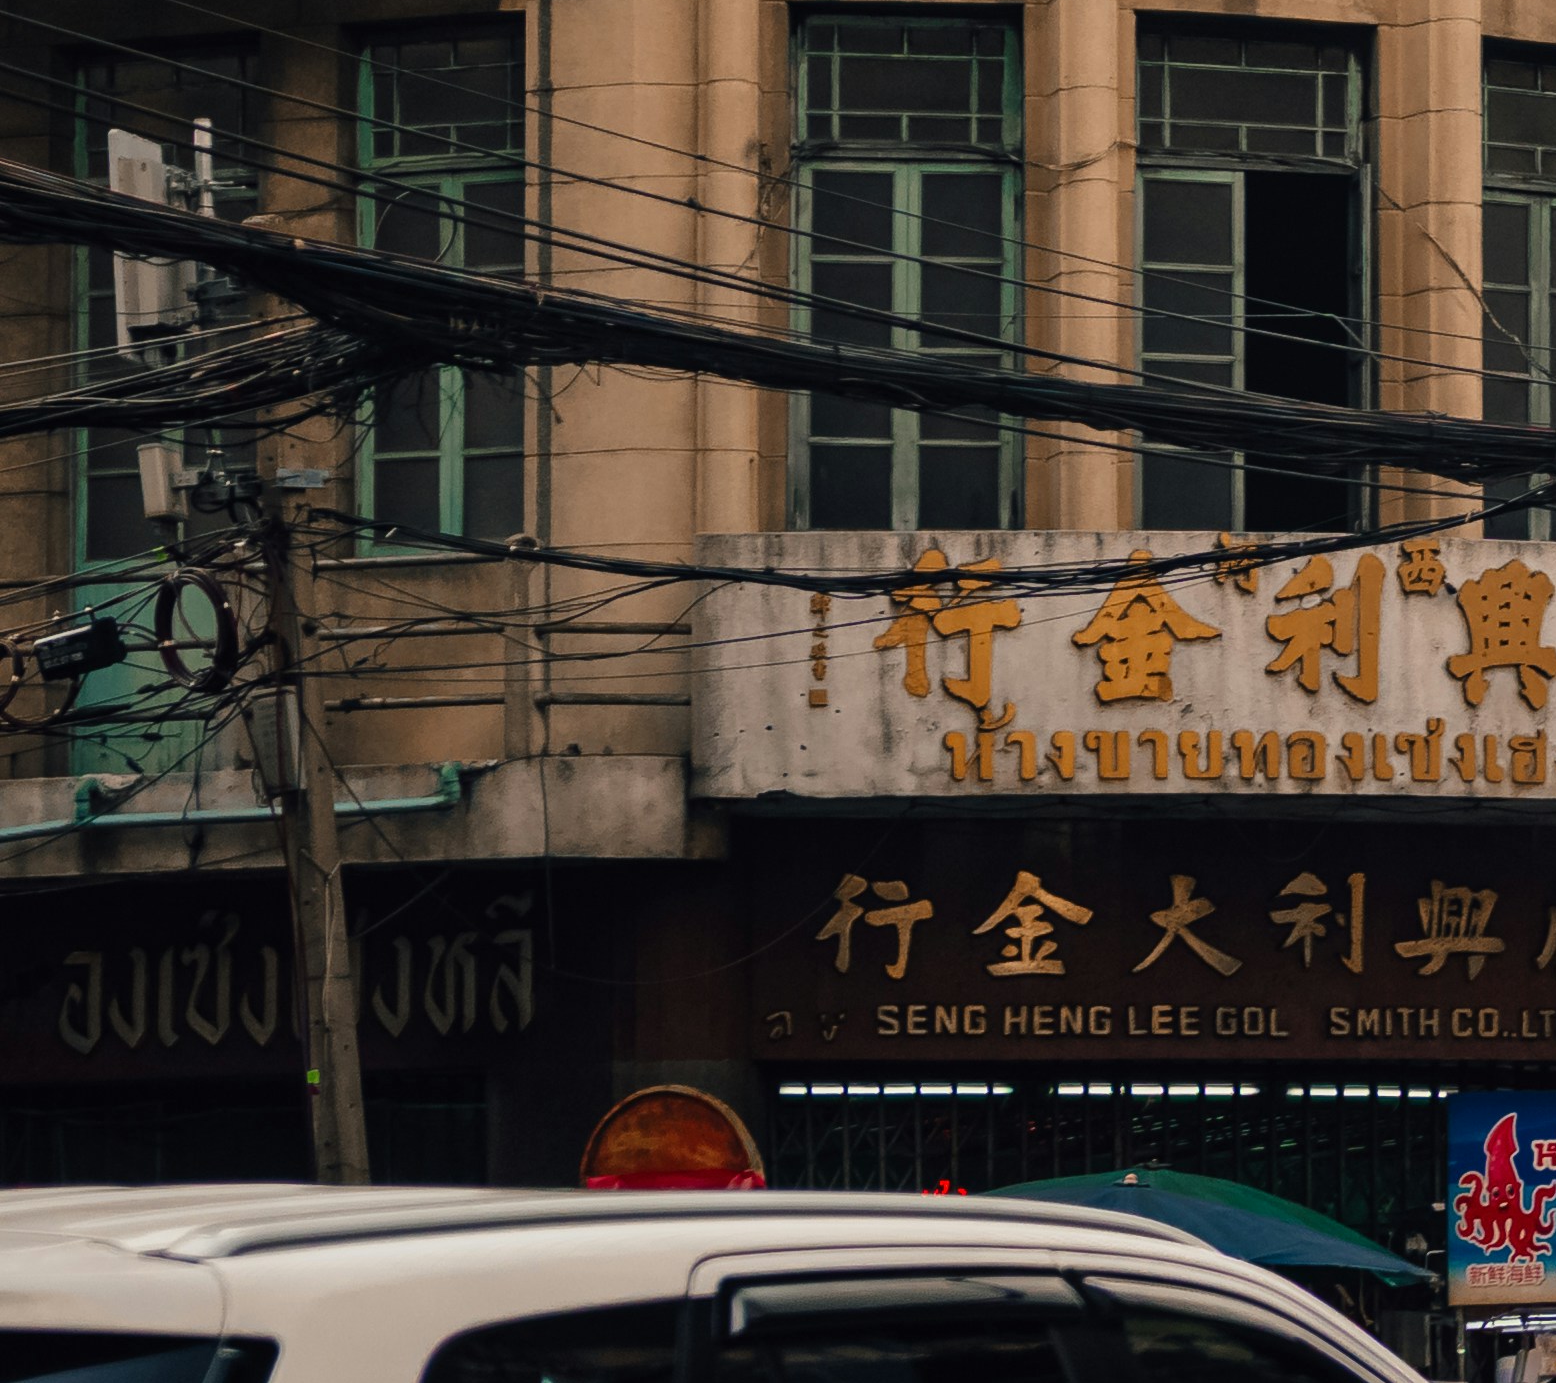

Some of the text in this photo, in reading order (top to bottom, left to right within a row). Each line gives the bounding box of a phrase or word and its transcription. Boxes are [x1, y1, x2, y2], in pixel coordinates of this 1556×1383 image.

[876, 1003, 988, 1038] SENG
[1002, 1003, 1114, 1038] HENG
[1125, 1003, 1201, 1038] LEE
[1328, 1004, 1442, 1040] SMITH
